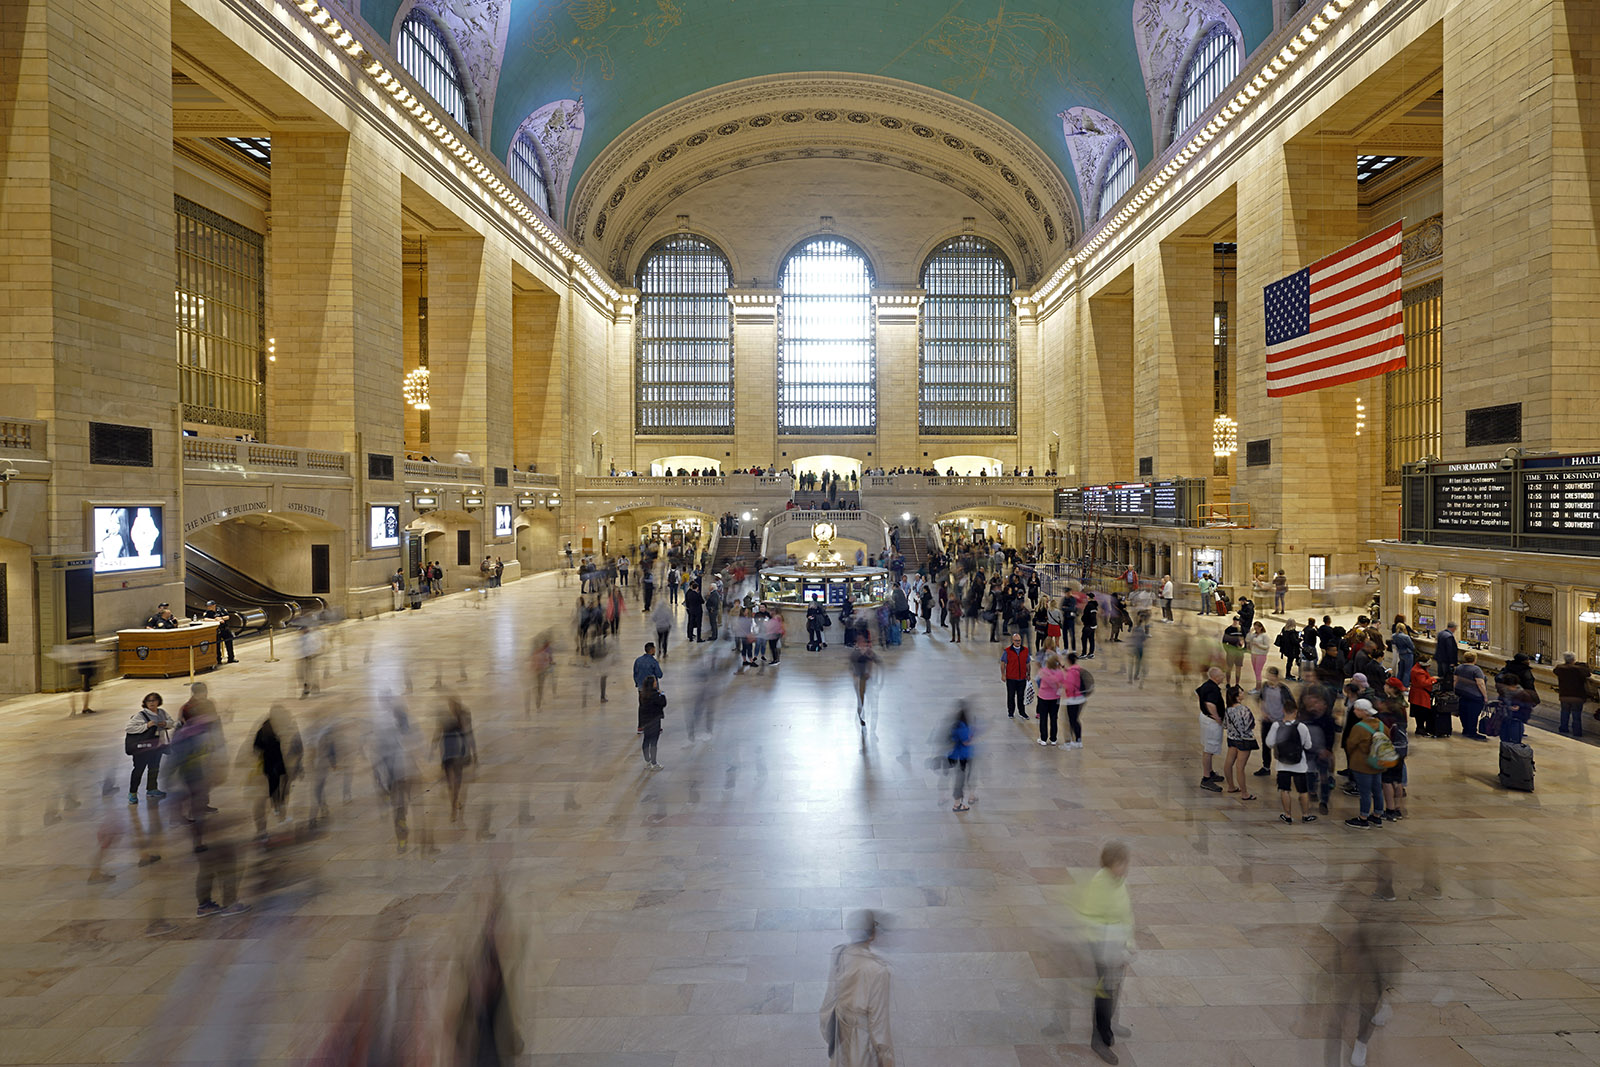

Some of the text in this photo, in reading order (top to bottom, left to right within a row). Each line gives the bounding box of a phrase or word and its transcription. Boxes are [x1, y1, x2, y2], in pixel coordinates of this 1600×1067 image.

[1448, 462, 1498, 472] INFORMATION
[1564, 482, 1594, 490] SOUTHEAST
[288, 502, 325, 516] 45TH STREET
[184, 519, 200, 532] THE
[233, 501, 267, 513] BUILDING
